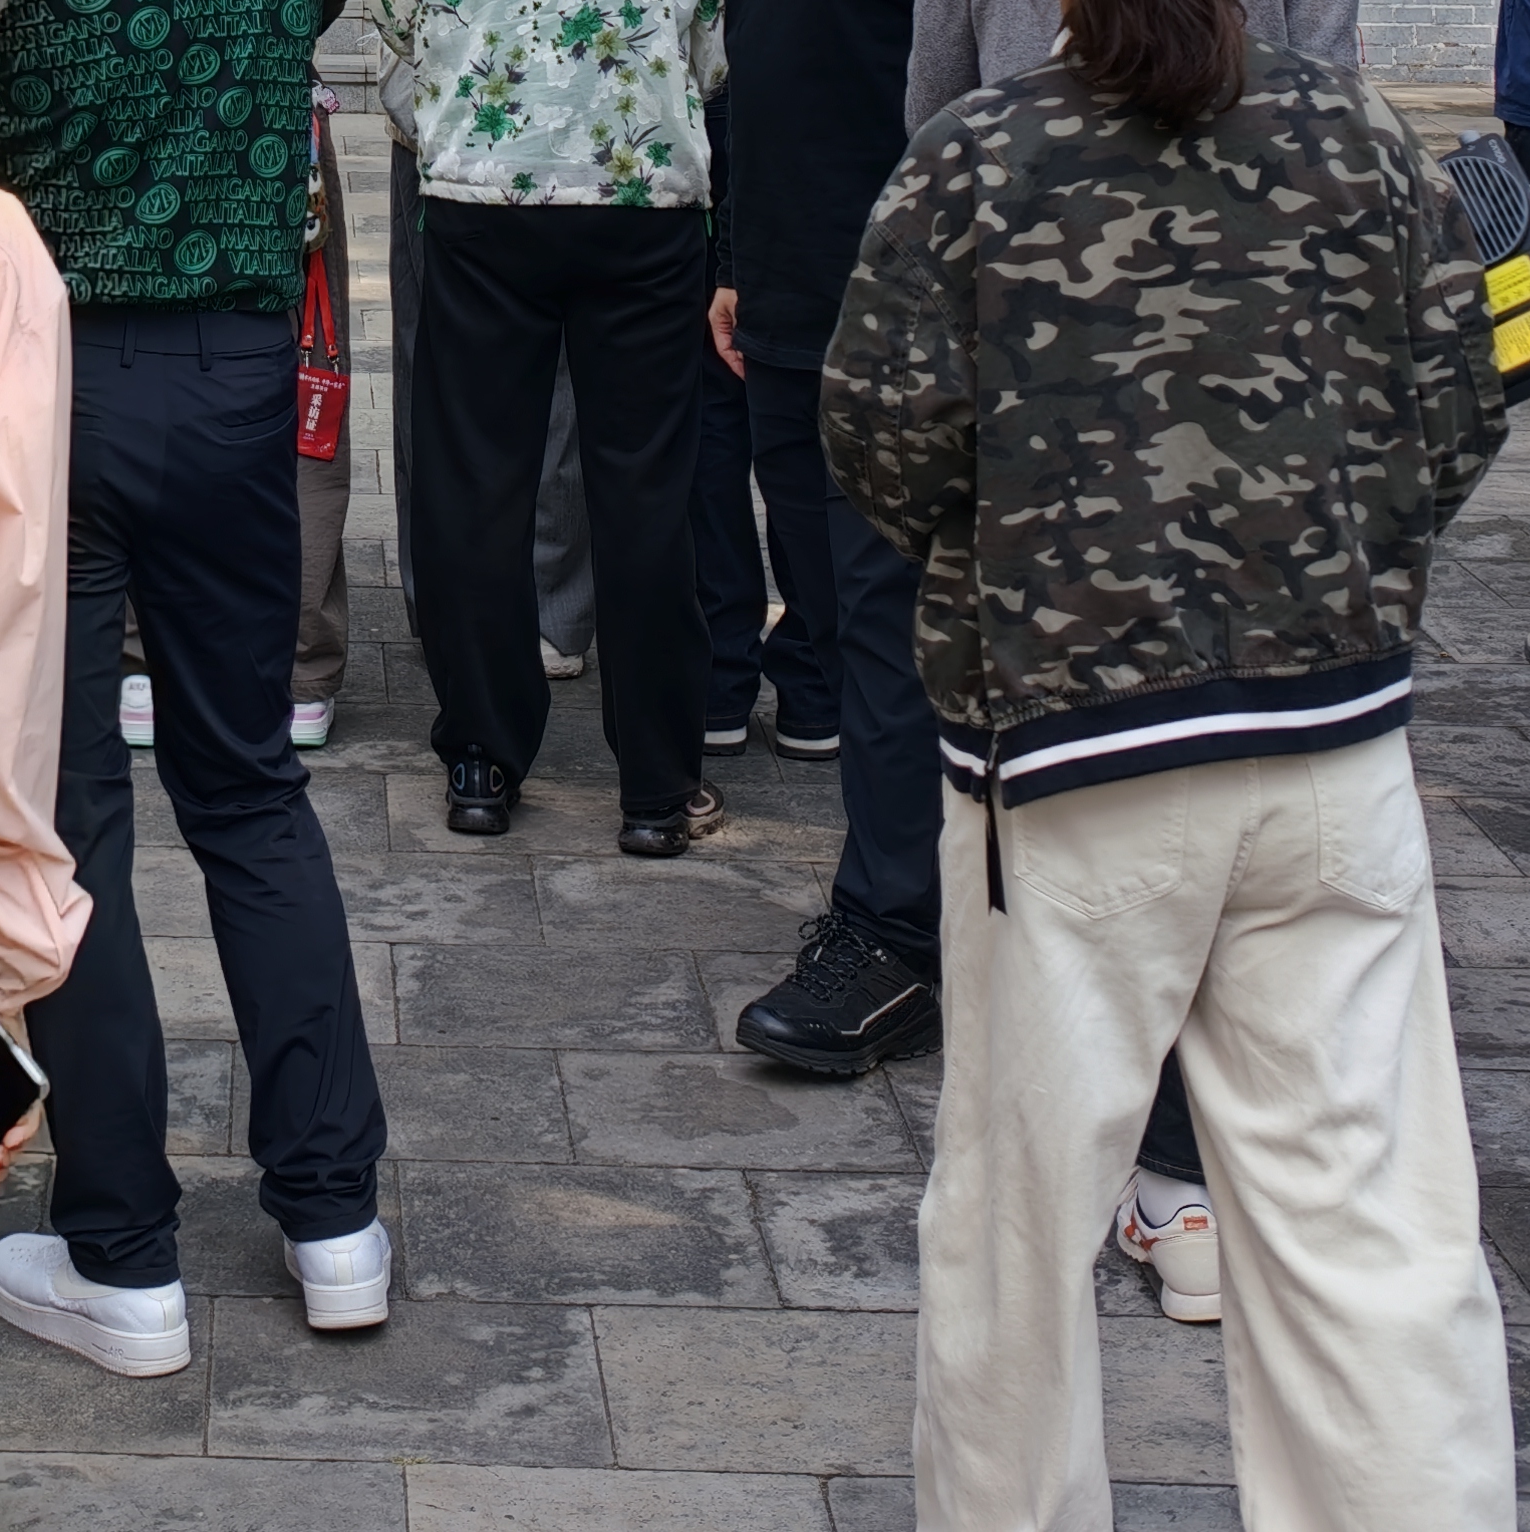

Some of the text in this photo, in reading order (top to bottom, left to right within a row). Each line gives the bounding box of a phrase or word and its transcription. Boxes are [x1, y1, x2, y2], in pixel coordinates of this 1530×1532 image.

[53, 48, 173, 89] MANGANO
[257, 83, 310, 107] MANG
[144, 130, 247, 160] MANGANO
[185, 178, 285, 202] MANGANO
[190, 202, 278, 226] VIAITALIA
[96, 272, 218, 298] MANGANO
[306, 393, 322, 431] 采访证
